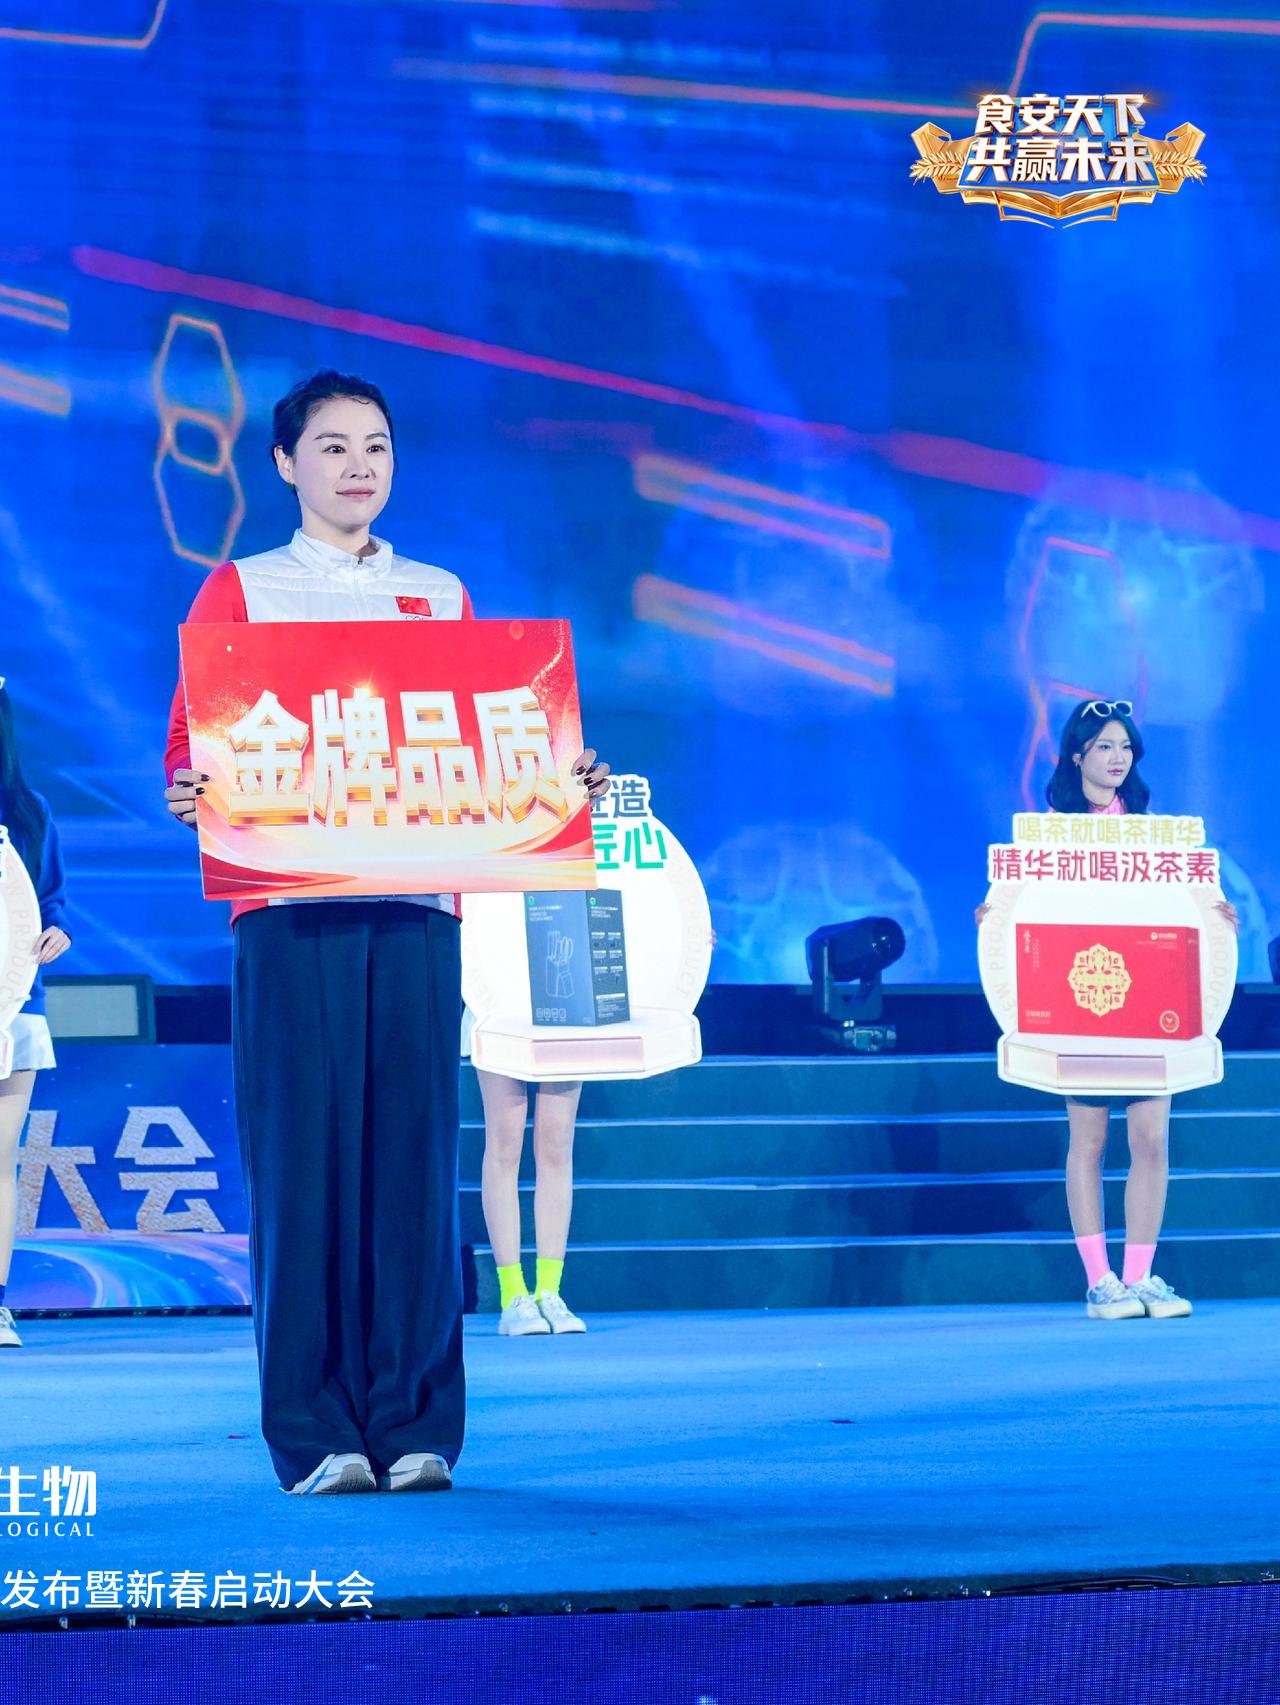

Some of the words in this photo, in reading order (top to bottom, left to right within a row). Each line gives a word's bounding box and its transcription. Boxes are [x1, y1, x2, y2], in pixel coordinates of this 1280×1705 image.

[228, 686, 570, 827] 金牌品质
[1017, 816, 1205, 846] 喝茶就喝茶精华
[991, 848, 1216, 884] 精华就喝汲茶素
